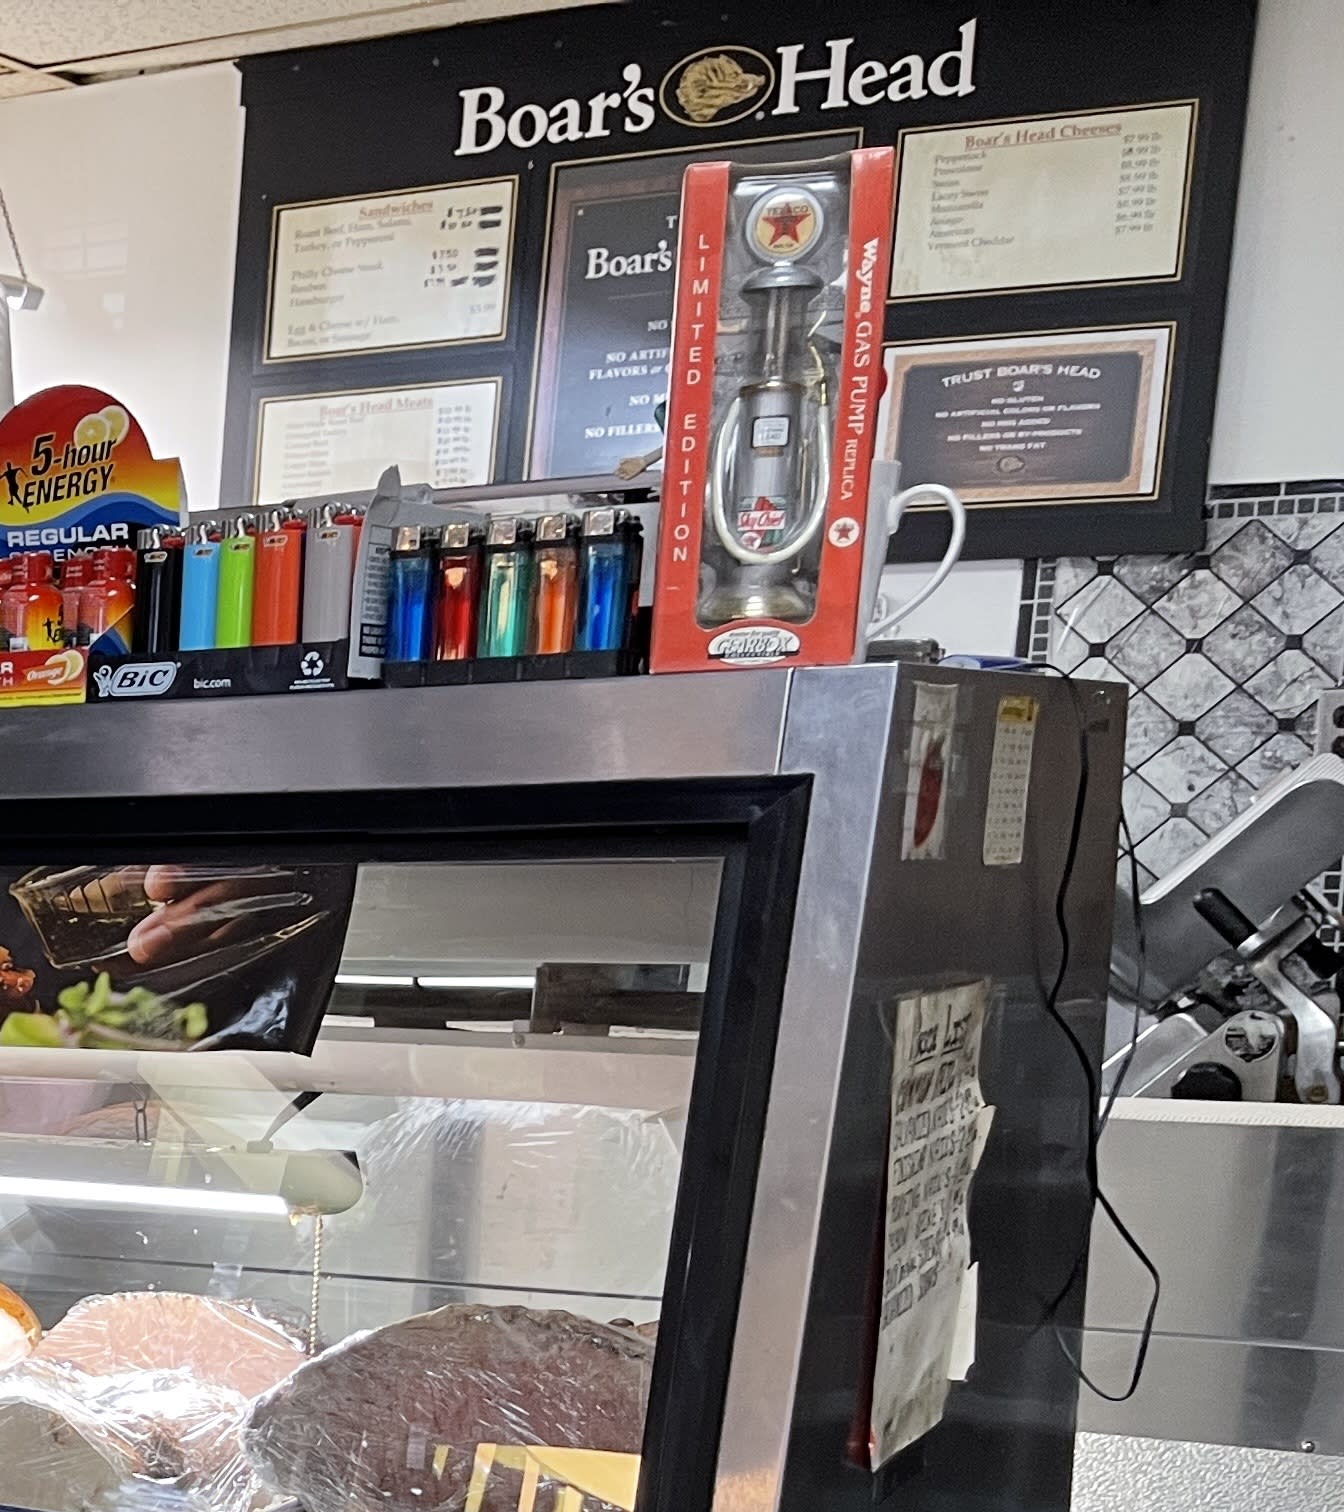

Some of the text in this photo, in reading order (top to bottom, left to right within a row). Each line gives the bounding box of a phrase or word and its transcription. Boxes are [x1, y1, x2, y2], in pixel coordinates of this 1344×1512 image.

[454, 17, 978, 156] Boar's Head
[965, 122, 1122, 147] Boar's Head Cheeses
[359, 200, 434, 219] Sandwiches
[585, 240, 672, 280] Boar's
[686, 234, 709, 385] LIMITED
[605, 348, 669, 364] NO ARTIF
[840, 237, 880, 500] Wayne GAS PUMP REPLICA
[588, 364, 648, 381] FLAVORS
[942, 364, 1101, 388] TRUST BOAR'S HEAD
[628, 395, 649, 406] NO
[584, 427, 605, 439] NO
[31, 434, 117, 477] 5-hour
[23, 463, 114, 508] ENERGY
[673, 413, 697, 562] EDITION
[7, 523, 129, 548] REGULAR
[193, 678, 232, 690] bic.com
